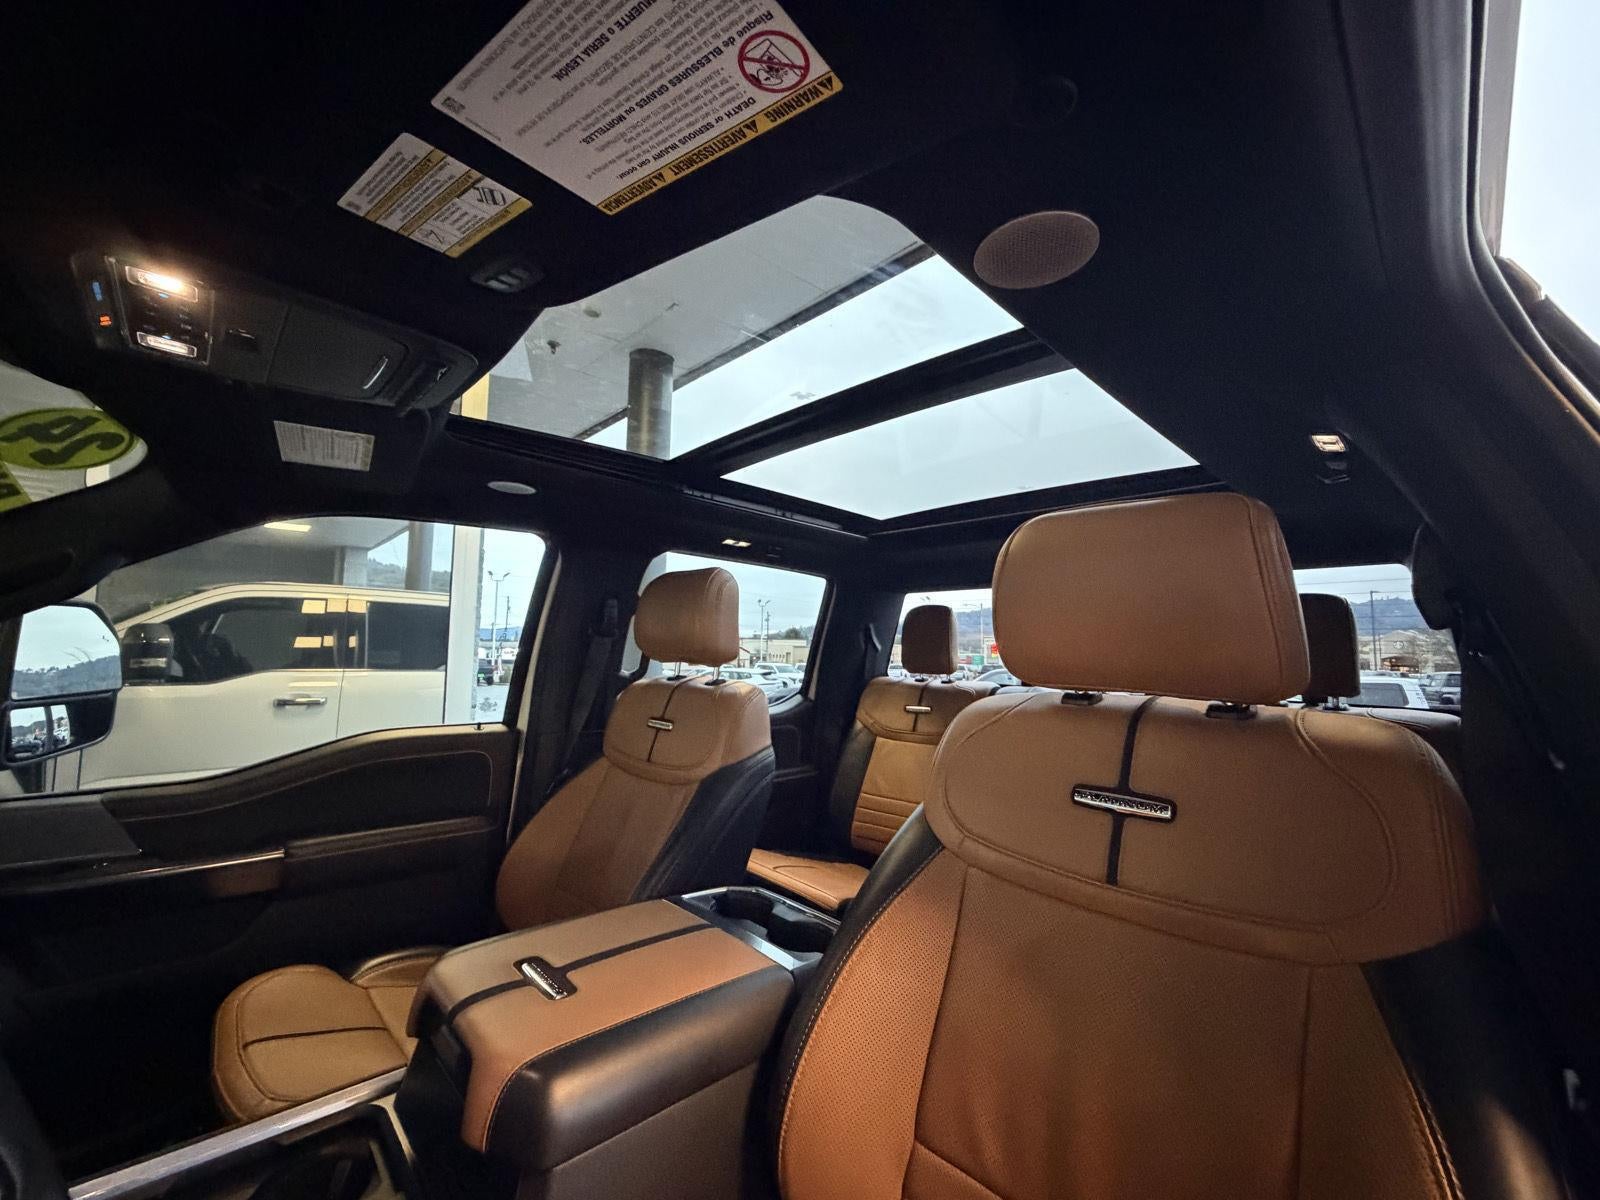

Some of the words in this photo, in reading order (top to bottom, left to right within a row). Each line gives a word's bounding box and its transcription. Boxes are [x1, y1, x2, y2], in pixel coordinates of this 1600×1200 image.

[733, 9, 774, 38] Risque
[579, 32, 611, 58] SERIA
[719, 34, 738, 49] de
[666, 45, 725, 87] BLESSURES
[634, 83, 670, 109] GRAVES
[723, 96, 757, 118] DEATH
[762, 84, 823, 123] WARNING
[623, 105, 636, 115] ou
[713, 115, 724, 123] or
[577, 113, 627, 145] MORTELLES.
[676, 121, 715, 145] SERIOUS
[635, 158, 651, 168] can
[650, 142, 679, 161] INJURY
[667, 127, 747, 175] AVERTISSEMENT
[600, 177, 658, 211] ADVERTENCIA
